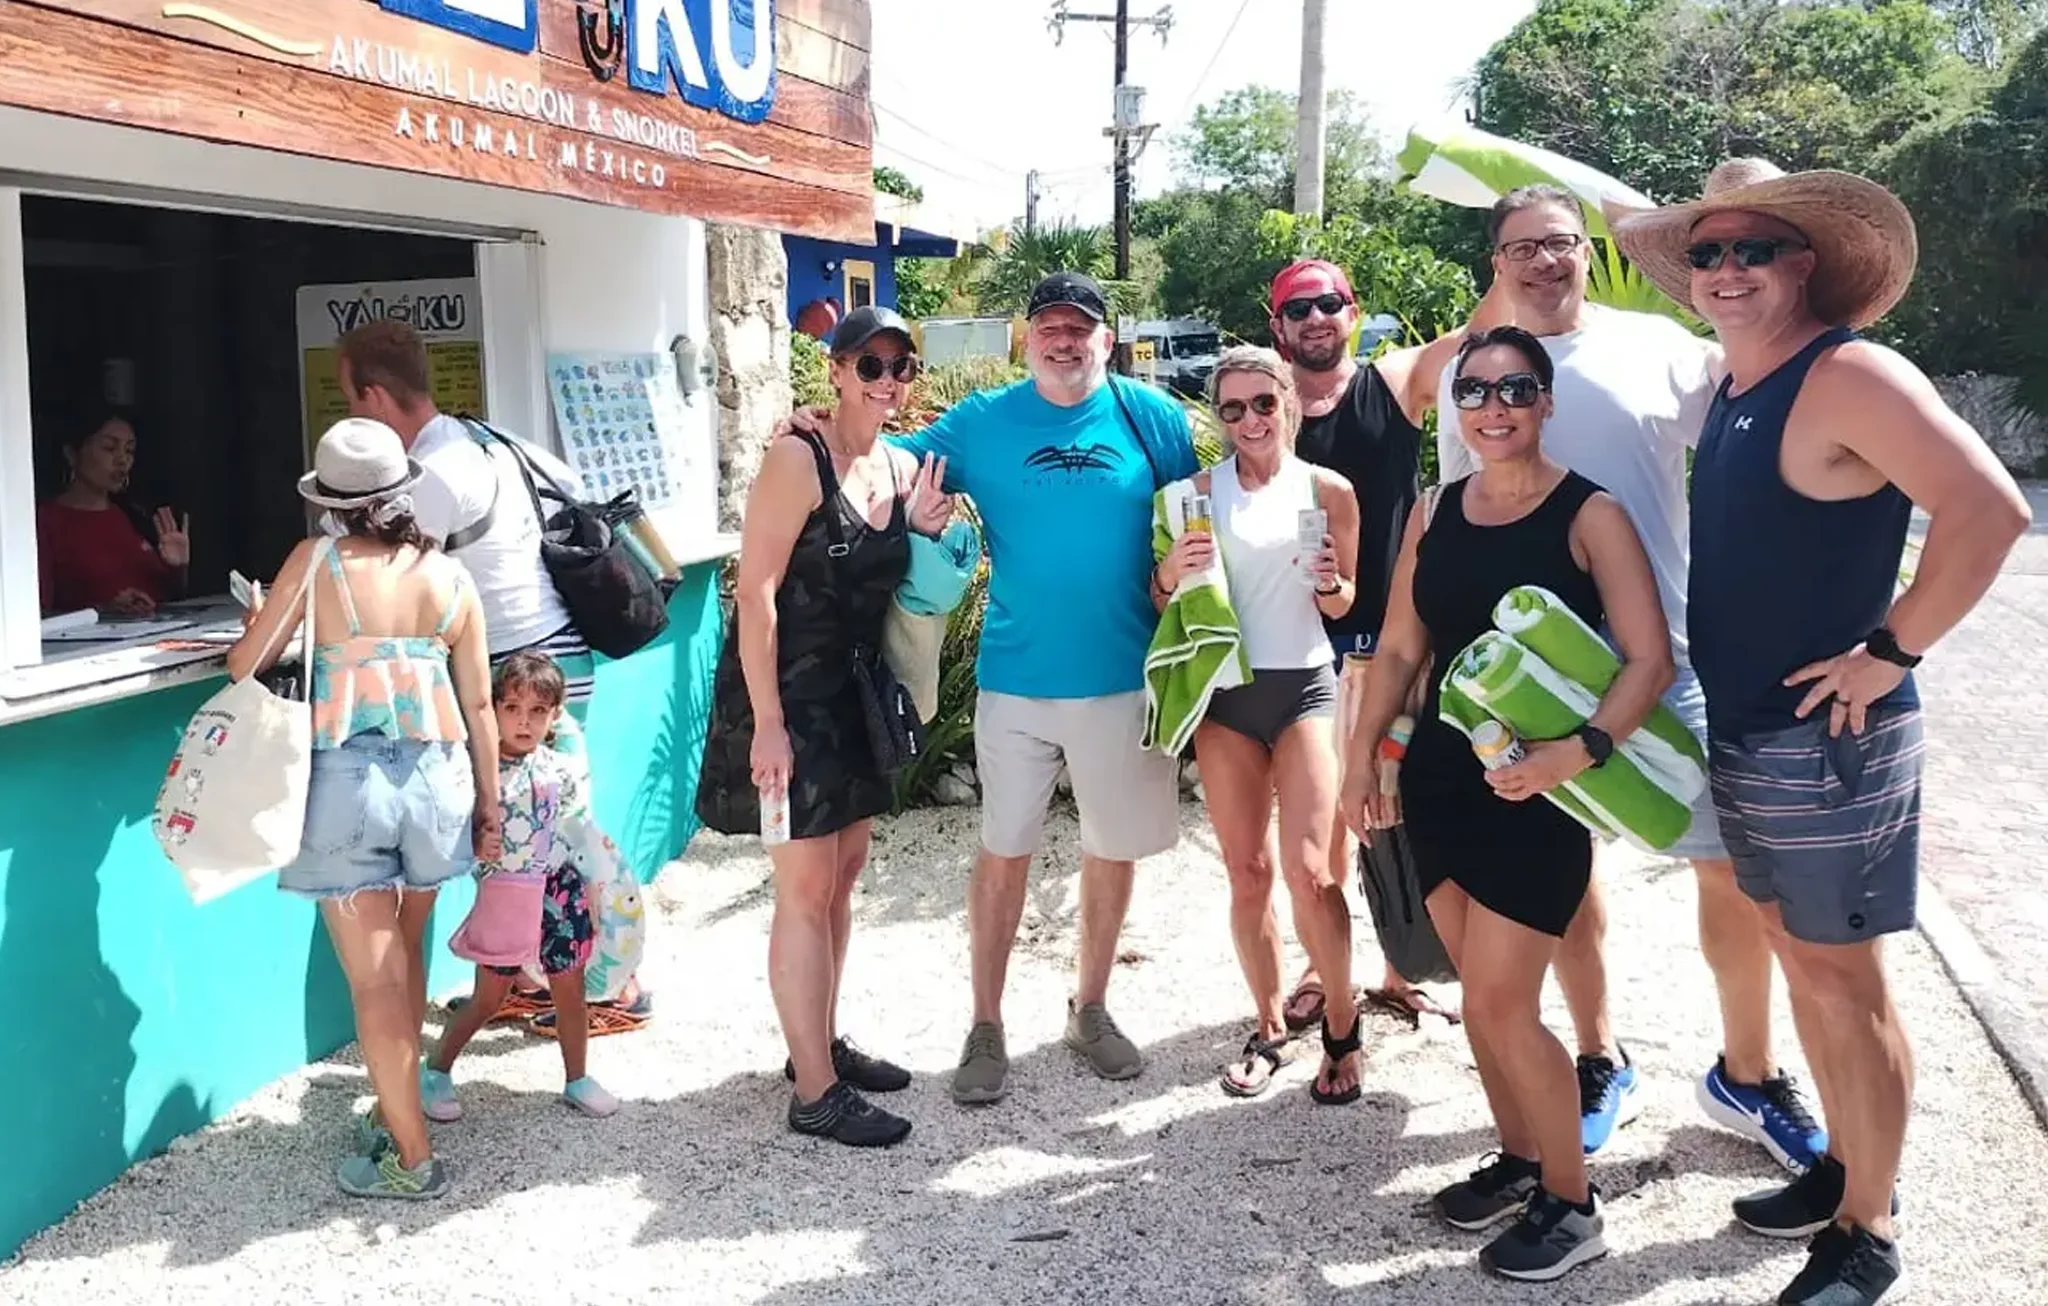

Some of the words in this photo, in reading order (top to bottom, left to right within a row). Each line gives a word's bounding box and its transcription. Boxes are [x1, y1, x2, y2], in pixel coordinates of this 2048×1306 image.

[328, 34, 458, 98] AKUMAL
[467, 67, 575, 124] LAGOON
[587, 101, 603, 134] &
[611, 107, 701, 158] SNORKEL
[395, 107, 538, 161] AKUMAL
[560, 141, 666, 188] MÉXICO
[1135, 350, 1153, 361] TC
